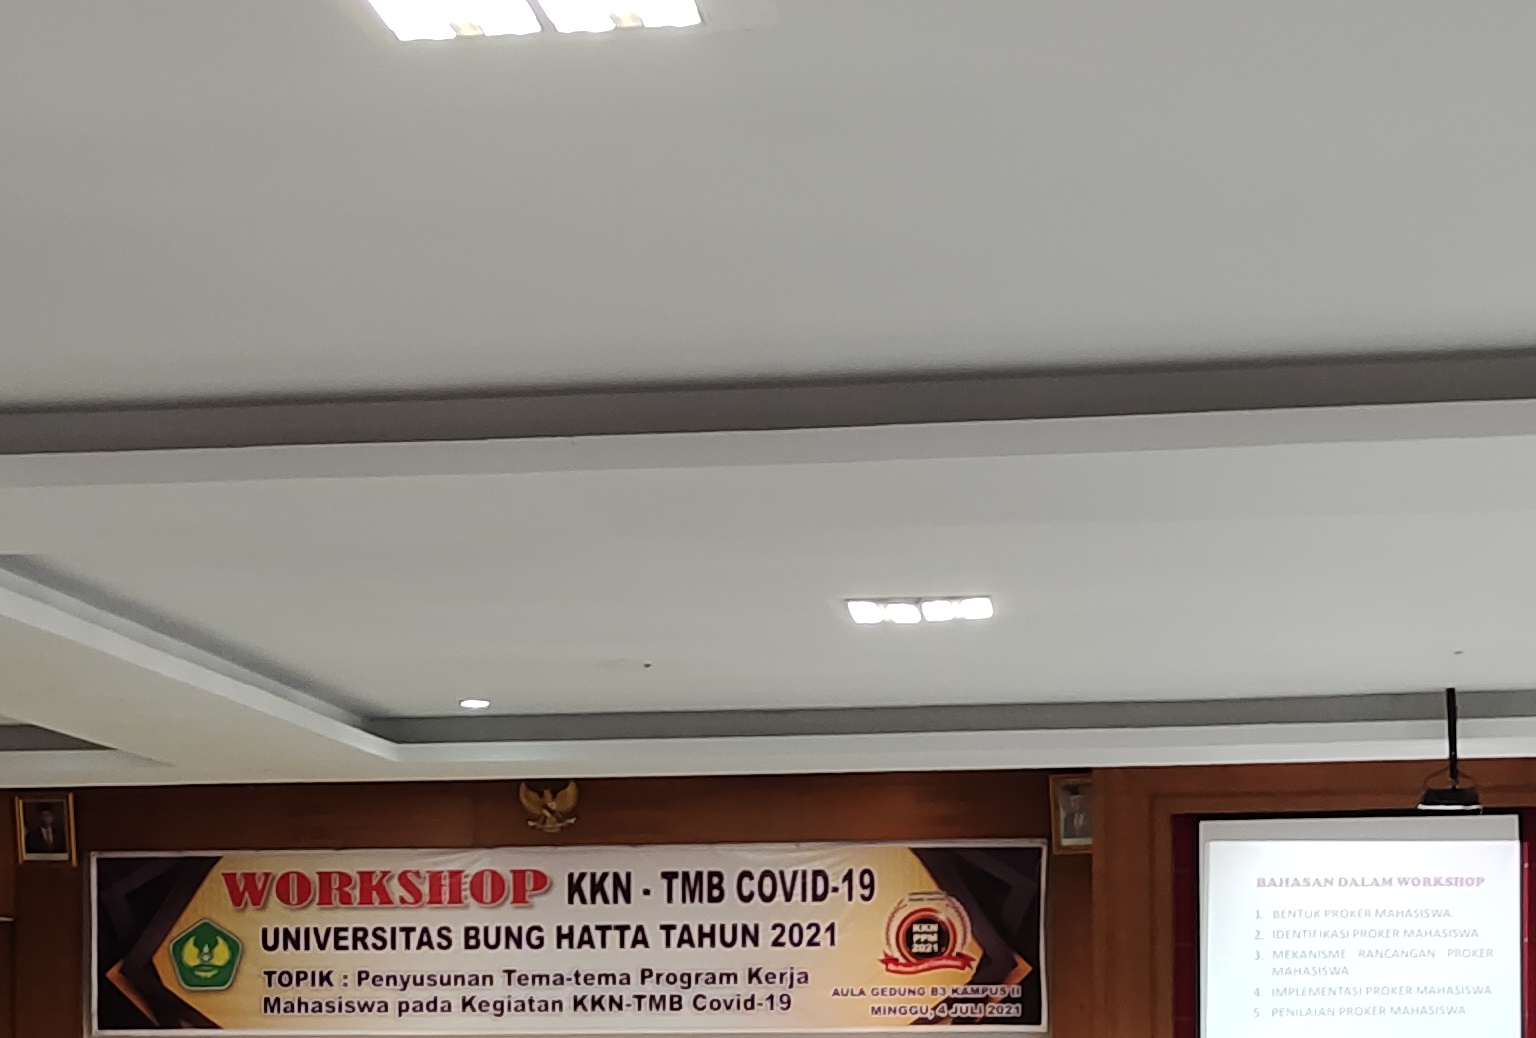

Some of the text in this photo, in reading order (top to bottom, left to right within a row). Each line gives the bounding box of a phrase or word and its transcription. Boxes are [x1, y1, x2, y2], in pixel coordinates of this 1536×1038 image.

[1257, 877, 1485, 887] BAHASAN DALAM WORKSHOP
[221, 868, 875, 909] WORKSHOP KKN - TMB COVID-19
[1273, 909, 1321, 919] BENTUK
[1325, 909, 1371, 919] PROKER
[262, 922, 837, 951] UNIVERSITAS BUNG HATTA TAHUN 2021
[1273, 929, 1349, 939] IDENTIFIKASI
[1353, 929, 1400, 939] PROKER
[1404, 929, 1478, 939] MAHASISWA
[1272, 949, 1346, 959] MEKANISME
[1359, 949, 1435, 959] RANCANGAN
[1448, 949, 1493, 959] PROKER
[1272, 966, 1349, 976] MAHASISWA
[263, 967, 809, 991] TOPIK : Penyusunan Tema-tema Program Kerja
[832, 987, 866, 997] AULA
[870, 987, 926, 996] GEDUNG
[952, 986, 1007, 996] KAMPUS
[1272, 986, 1362, 996] IMPLEMENTASI
[1366, 986, 1412, 996] PROKER
[1416, 986, 1491, 996] MAHASISWA
[263, 993, 792, 1018] Mahasiswa pada Kegiatan KKN-TMB Covid-19
[937, 1005, 949, 1015] 4
[950, 1004, 984, 1015] JULI
[987, 1004, 1022, 1016] 2021
[1272, 1006, 1335, 1017] PENILAIAN
[1340, 1006, 1386, 1017] PROKER
[1390, 1006, 1465, 1017] MAHASISWA
